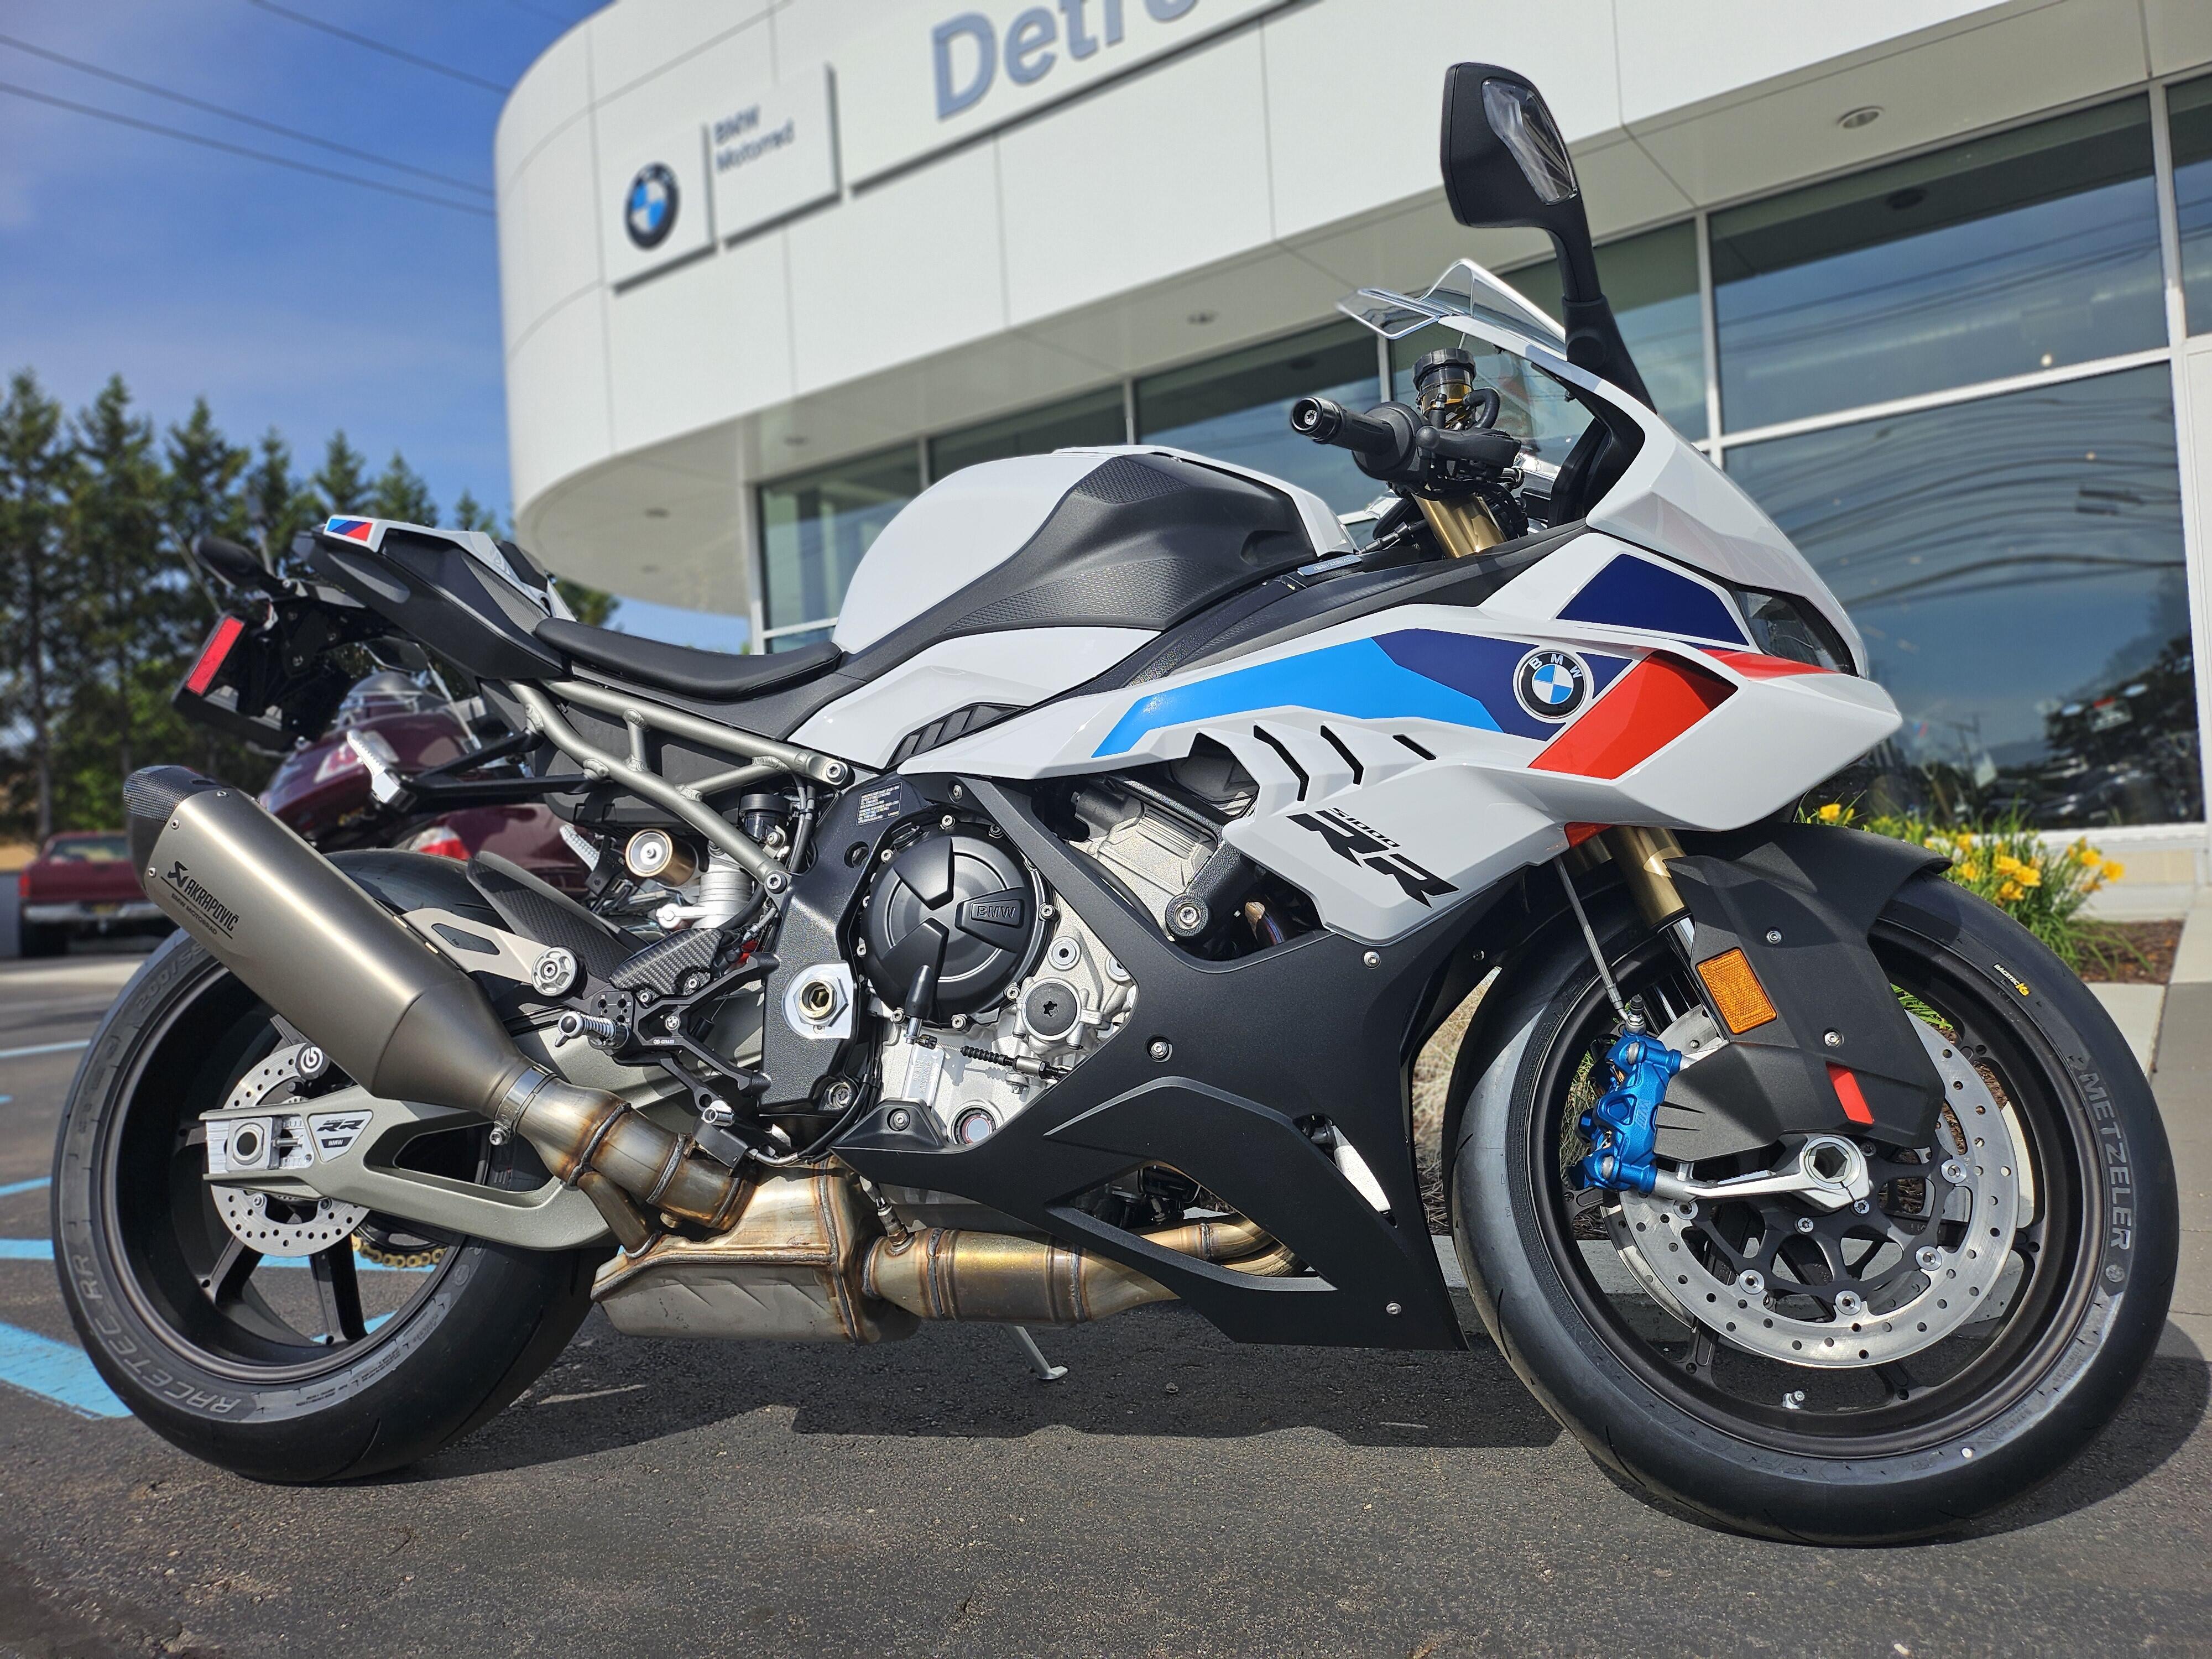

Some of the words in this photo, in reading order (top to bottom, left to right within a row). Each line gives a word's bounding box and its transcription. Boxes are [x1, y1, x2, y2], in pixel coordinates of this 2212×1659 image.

[1528, 653, 1583, 679] BMW
[1327, 807, 1402, 848] S1000
[1285, 809, 1460, 910] RR
[185, 905, 218, 936] MOTORRAD
[976, 905, 1016, 919] BMW
[316, 1119, 366, 1132] RR
[2078, 1071, 2132, 1251] METZELER
[72, 1254, 103, 1300] RR
[91, 1313, 242, 1414] RACETEC
